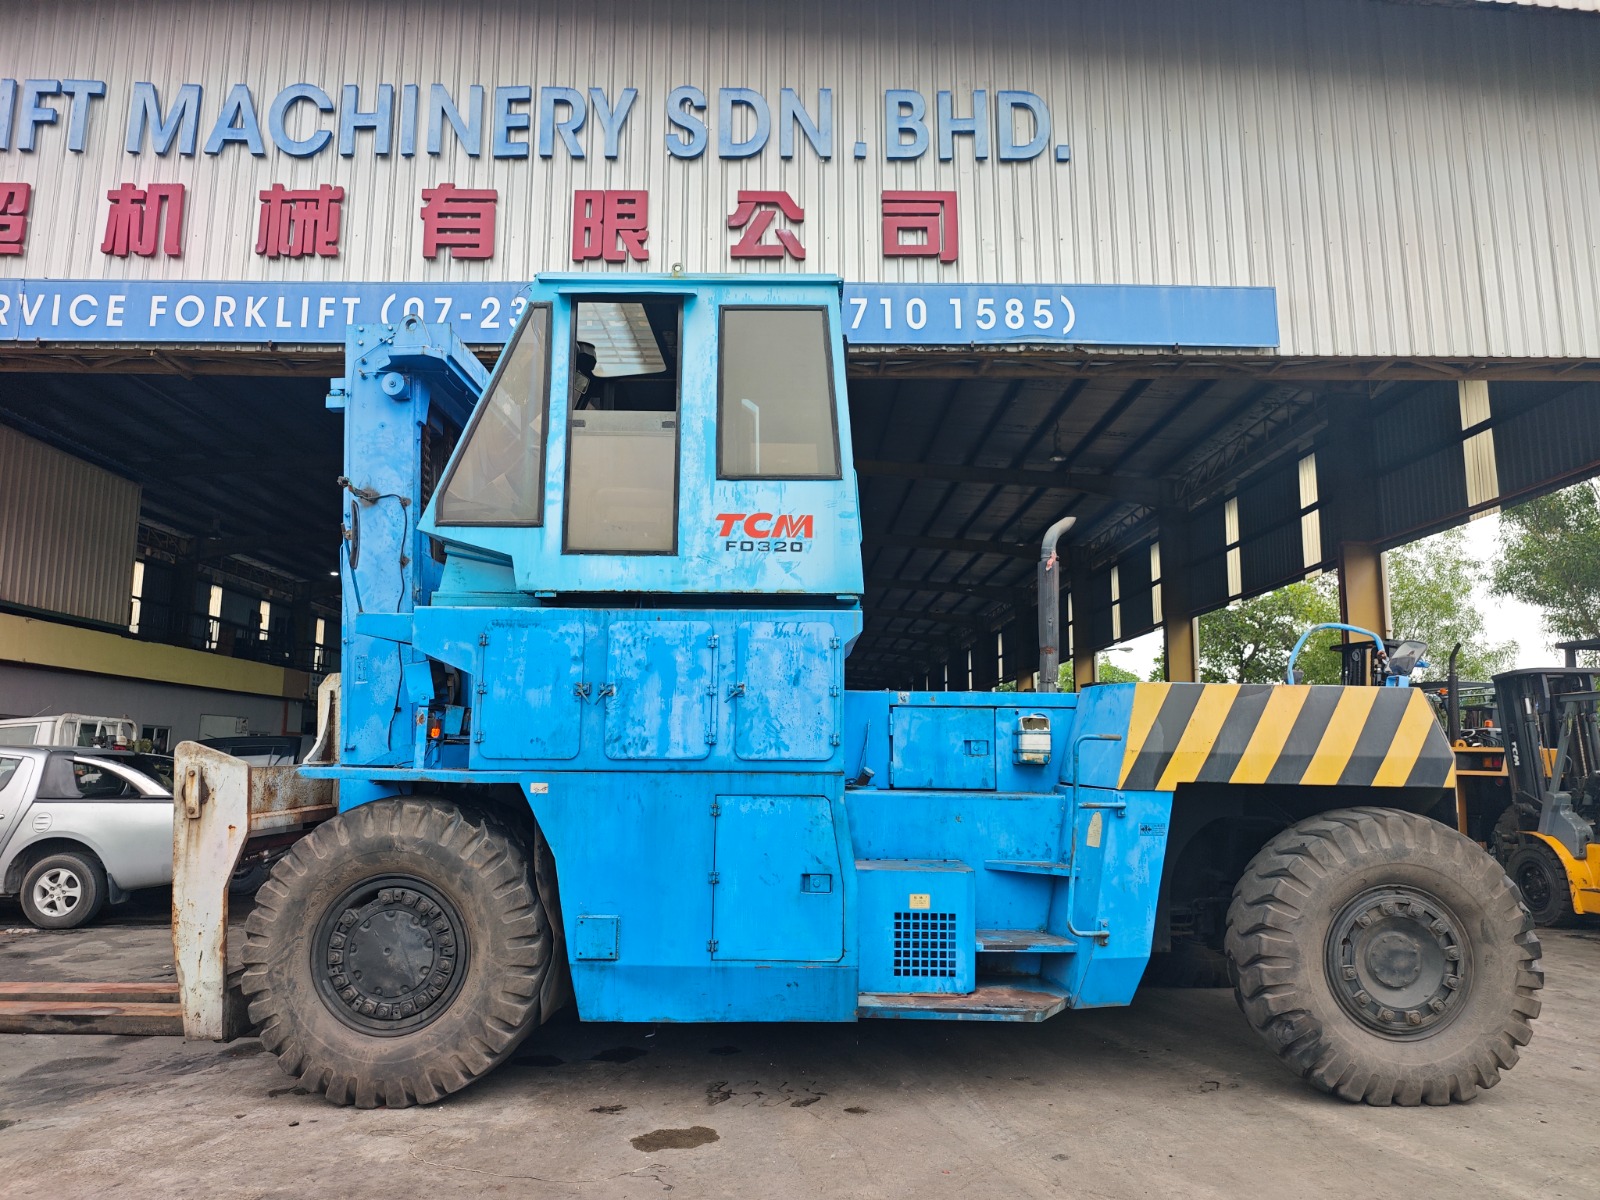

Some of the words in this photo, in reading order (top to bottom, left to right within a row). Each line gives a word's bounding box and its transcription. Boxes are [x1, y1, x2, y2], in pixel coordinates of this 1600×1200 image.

[126, 81, 638, 160] MACHINERY
[149, 295, 361, 328] FORKLIFT
[850, 297, 927, 330] 710
[949, 295, 1076, 335] 1585)
[715, 512, 814, 539] TCM
[1511, 741, 1520, 766] TCM
